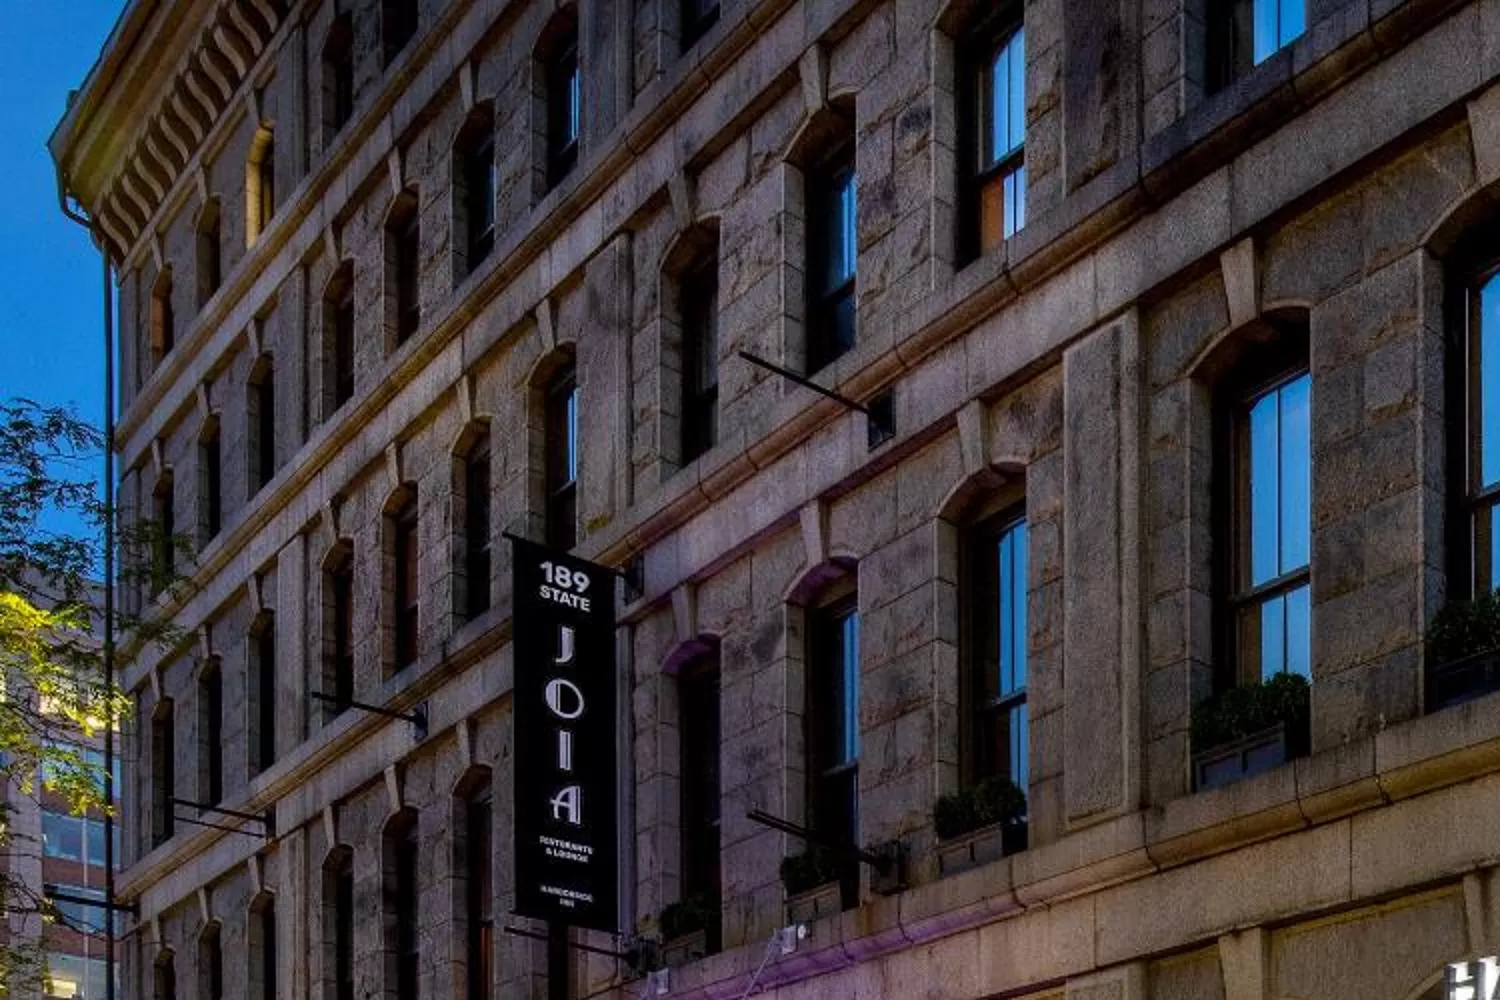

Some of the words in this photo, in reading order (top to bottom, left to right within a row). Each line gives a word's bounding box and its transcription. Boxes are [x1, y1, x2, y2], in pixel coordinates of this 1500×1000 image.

[540, 561, 591, 593] 189
[539, 585, 591, 612] STATE
[545, 625, 585, 825] JOIA
